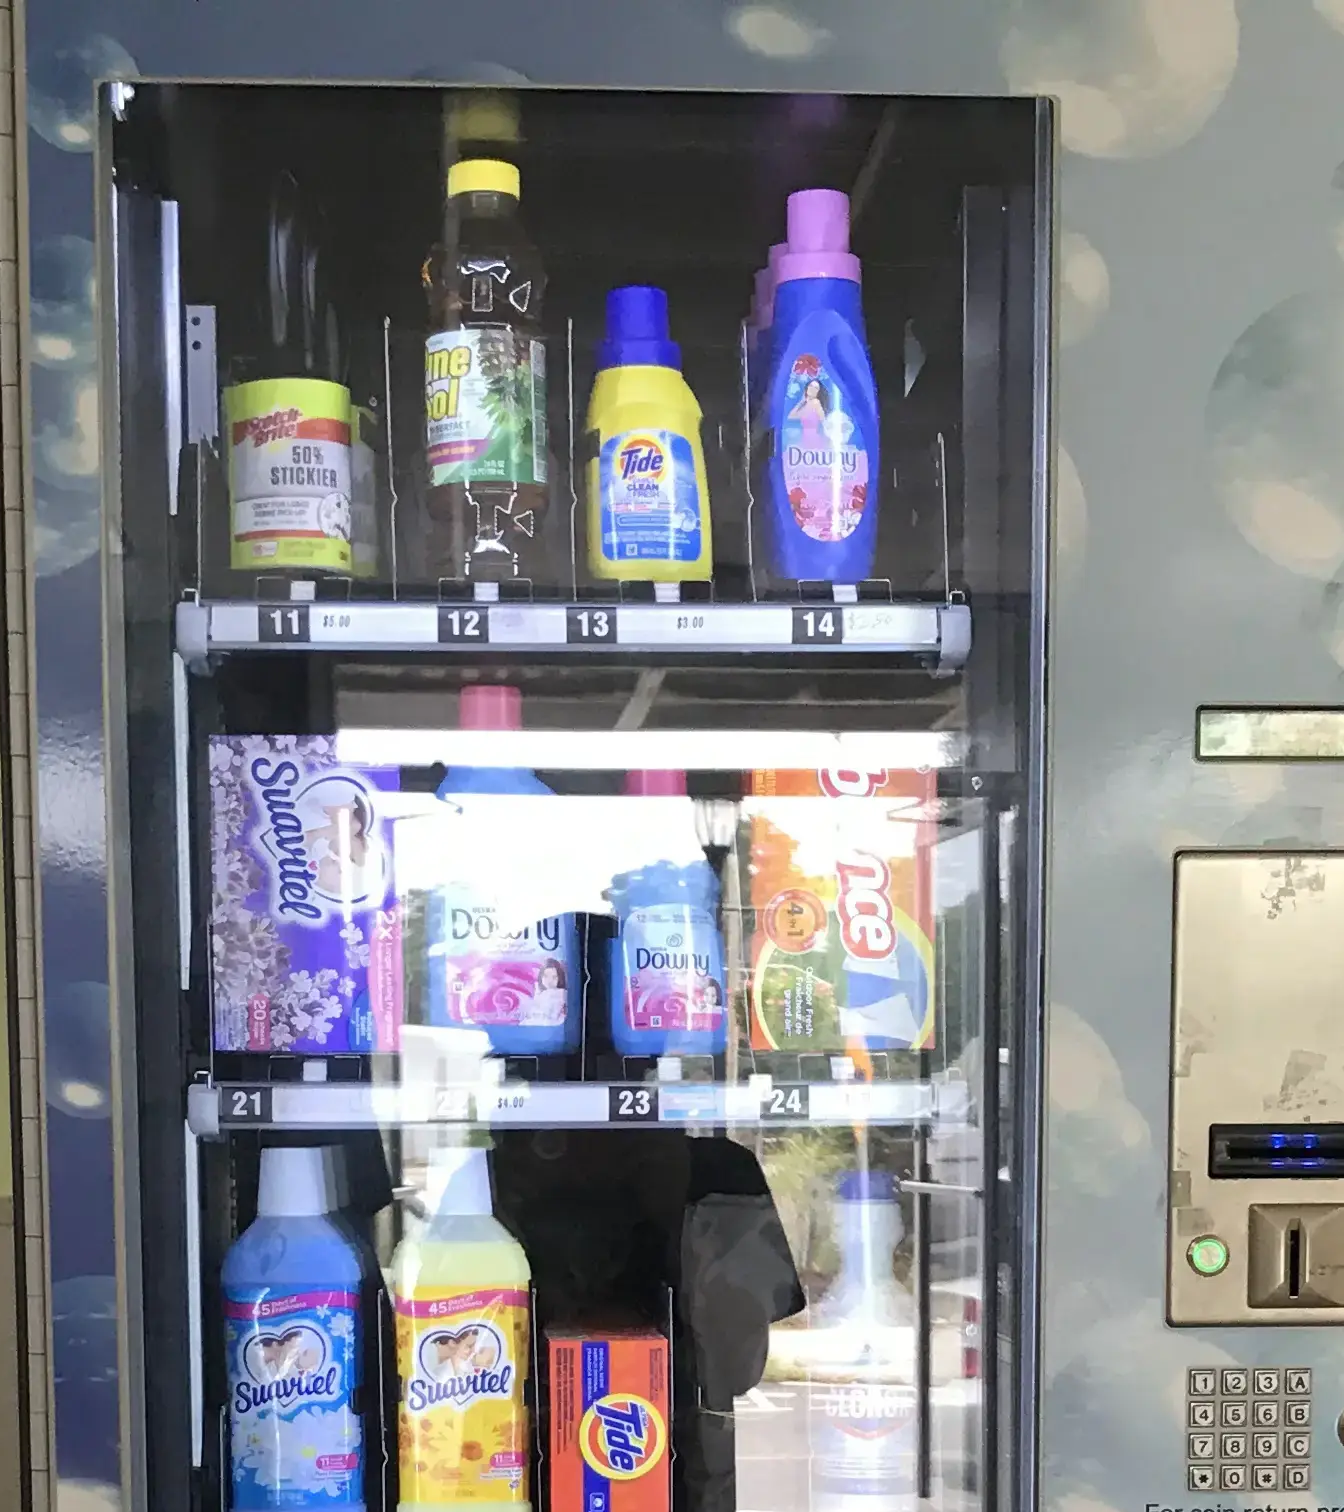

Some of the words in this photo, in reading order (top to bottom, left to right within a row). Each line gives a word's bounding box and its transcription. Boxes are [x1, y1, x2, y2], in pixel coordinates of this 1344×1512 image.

[292, 446, 324, 465] 50%
[620, 447, 664, 480] Tide
[788, 447, 856, 471] Downy
[270, 466, 338, 488] STICKIER
[269, 611, 300, 635] 11
[448, 611, 481, 636] 12
[576, 612, 609, 637] 13
[677, 616, 705, 630] $3.00
[803, 612, 835, 636] 14
[250, 756, 322, 921] Suavitel
[636, 948, 710, 977] Downy
[232, 1093, 261, 1115] 21
[619, 1091, 650, 1114] 23
[771, 1089, 801, 1113] 24
[428, 1302, 448, 1316] 45
[235, 1367, 337, 1414] Suavitel
[409, 1365, 511, 1411] Suavitel
[1201, 1377, 1209, 1390] 1
[1232, 1377, 1242, 1391] 2
[1263, 1377, 1274, 1391] 3
[1295, 1377, 1306, 1390] A
[1198, 1409, 1209, 1422] 4
[1231, 1409, 1241, 1422] 5
[1262, 1409, 1273, 1422] 6
[1294, 1409, 1305, 1422] B
[594, 1400, 646, 1472] Tide
[1198, 1441, 1208, 1454] 7
[1230, 1441, 1240, 1454] 8
[1262, 1441, 1272, 1454] 9
[1294, 1441, 1305, 1453] C
[1293, 1472, 1304, 1485] D
